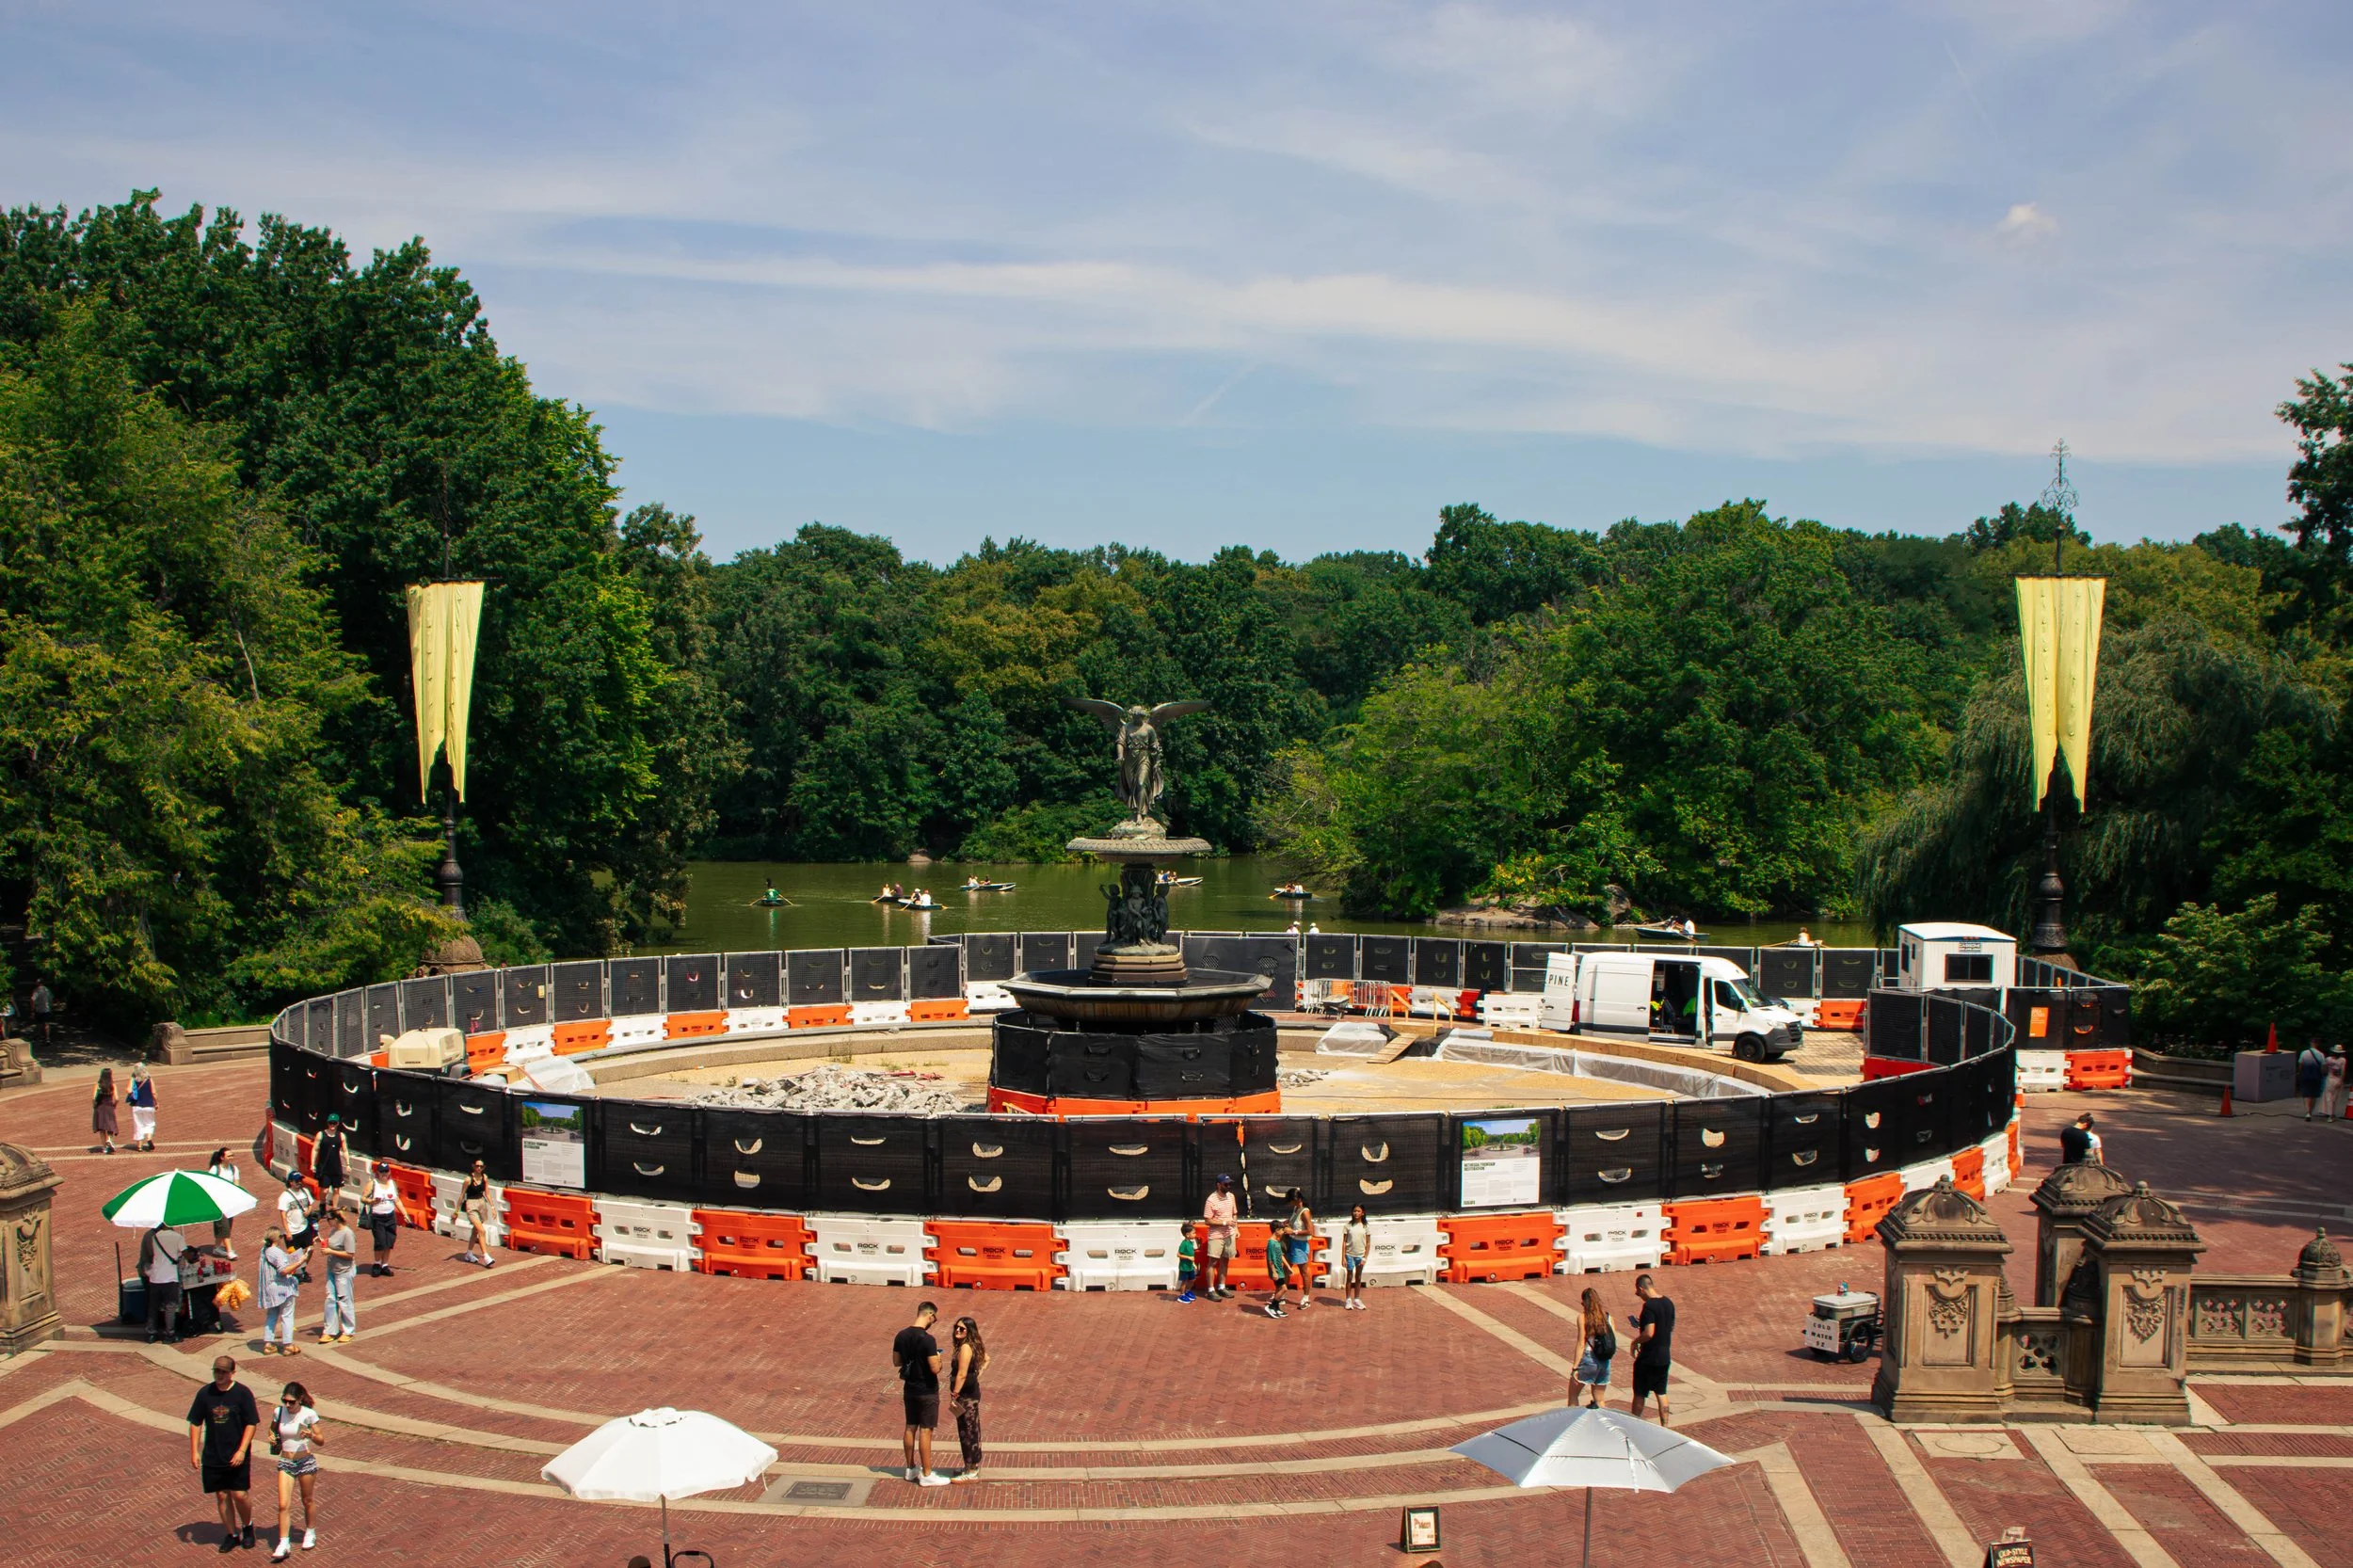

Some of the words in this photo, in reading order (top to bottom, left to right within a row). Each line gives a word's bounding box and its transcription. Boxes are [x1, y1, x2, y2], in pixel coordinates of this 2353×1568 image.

[1548, 974, 1570, 986] PINE
[1811, 1332, 1833, 1340] WATER
[1996, 1556, 2032, 1567] NEWSPAPER
